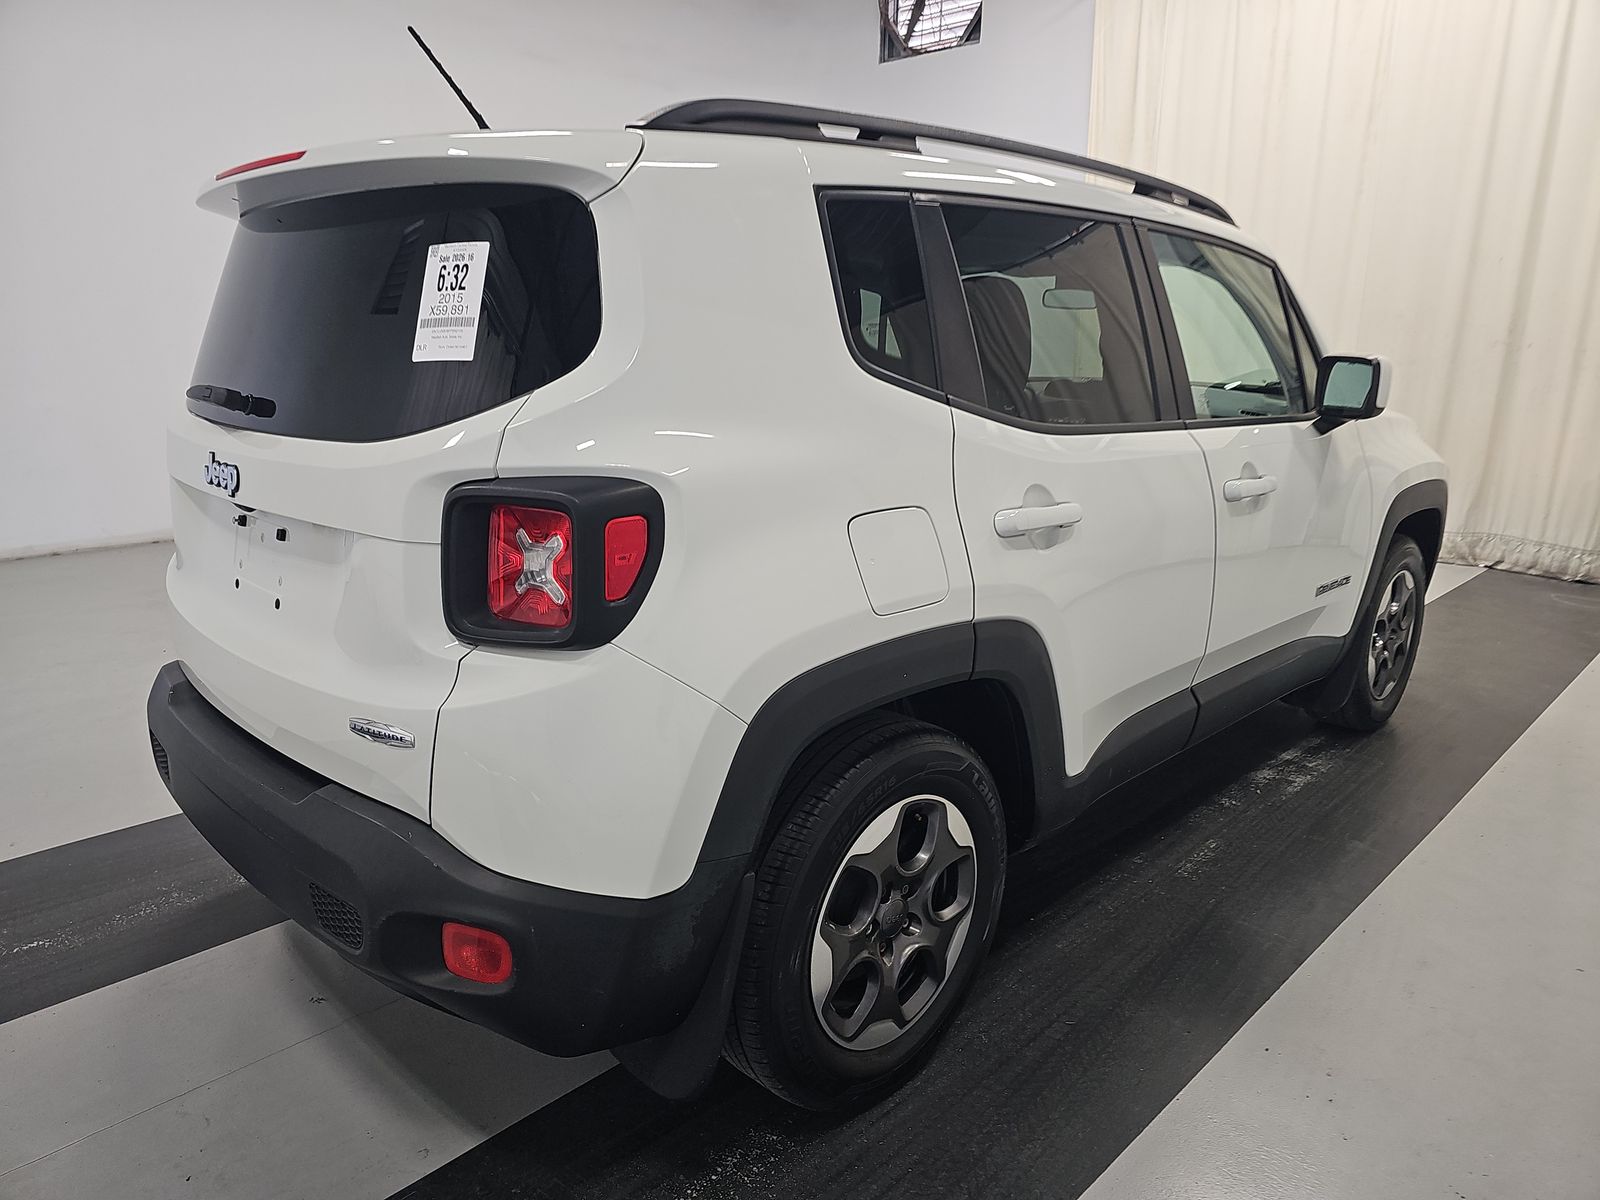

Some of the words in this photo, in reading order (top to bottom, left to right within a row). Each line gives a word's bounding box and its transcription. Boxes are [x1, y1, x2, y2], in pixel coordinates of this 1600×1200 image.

[437, 264, 469, 292] 6:32
[438, 293, 463, 304] 2015
[204, 451, 240, 498] Jeep
[353, 723, 407, 742] LATITUDE
